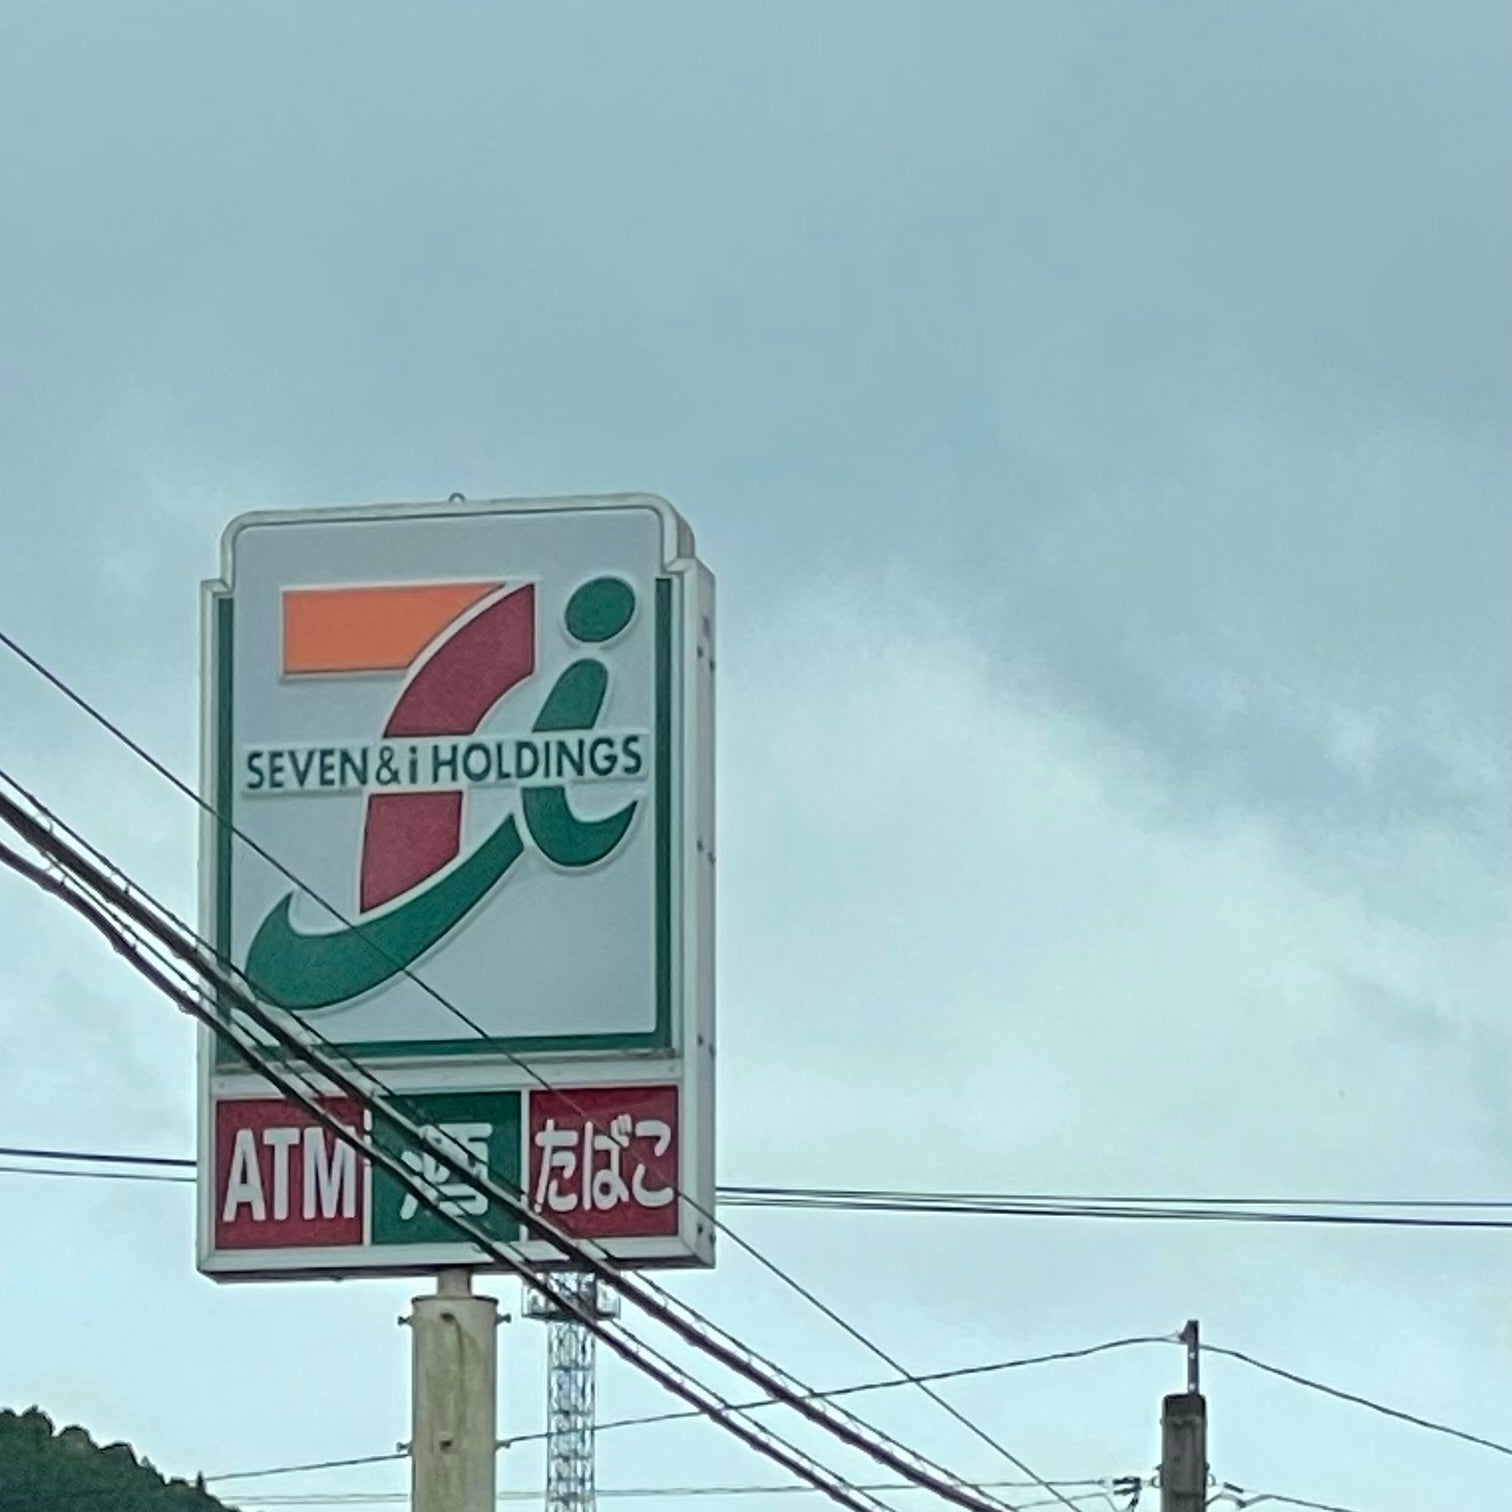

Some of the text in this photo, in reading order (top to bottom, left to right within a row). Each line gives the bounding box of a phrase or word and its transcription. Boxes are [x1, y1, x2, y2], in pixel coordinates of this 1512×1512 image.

[431, 735, 642, 784] HOLDINGS
[222, 1126, 357, 1223] ATM
[533, 1113, 675, 1214] たばこ
